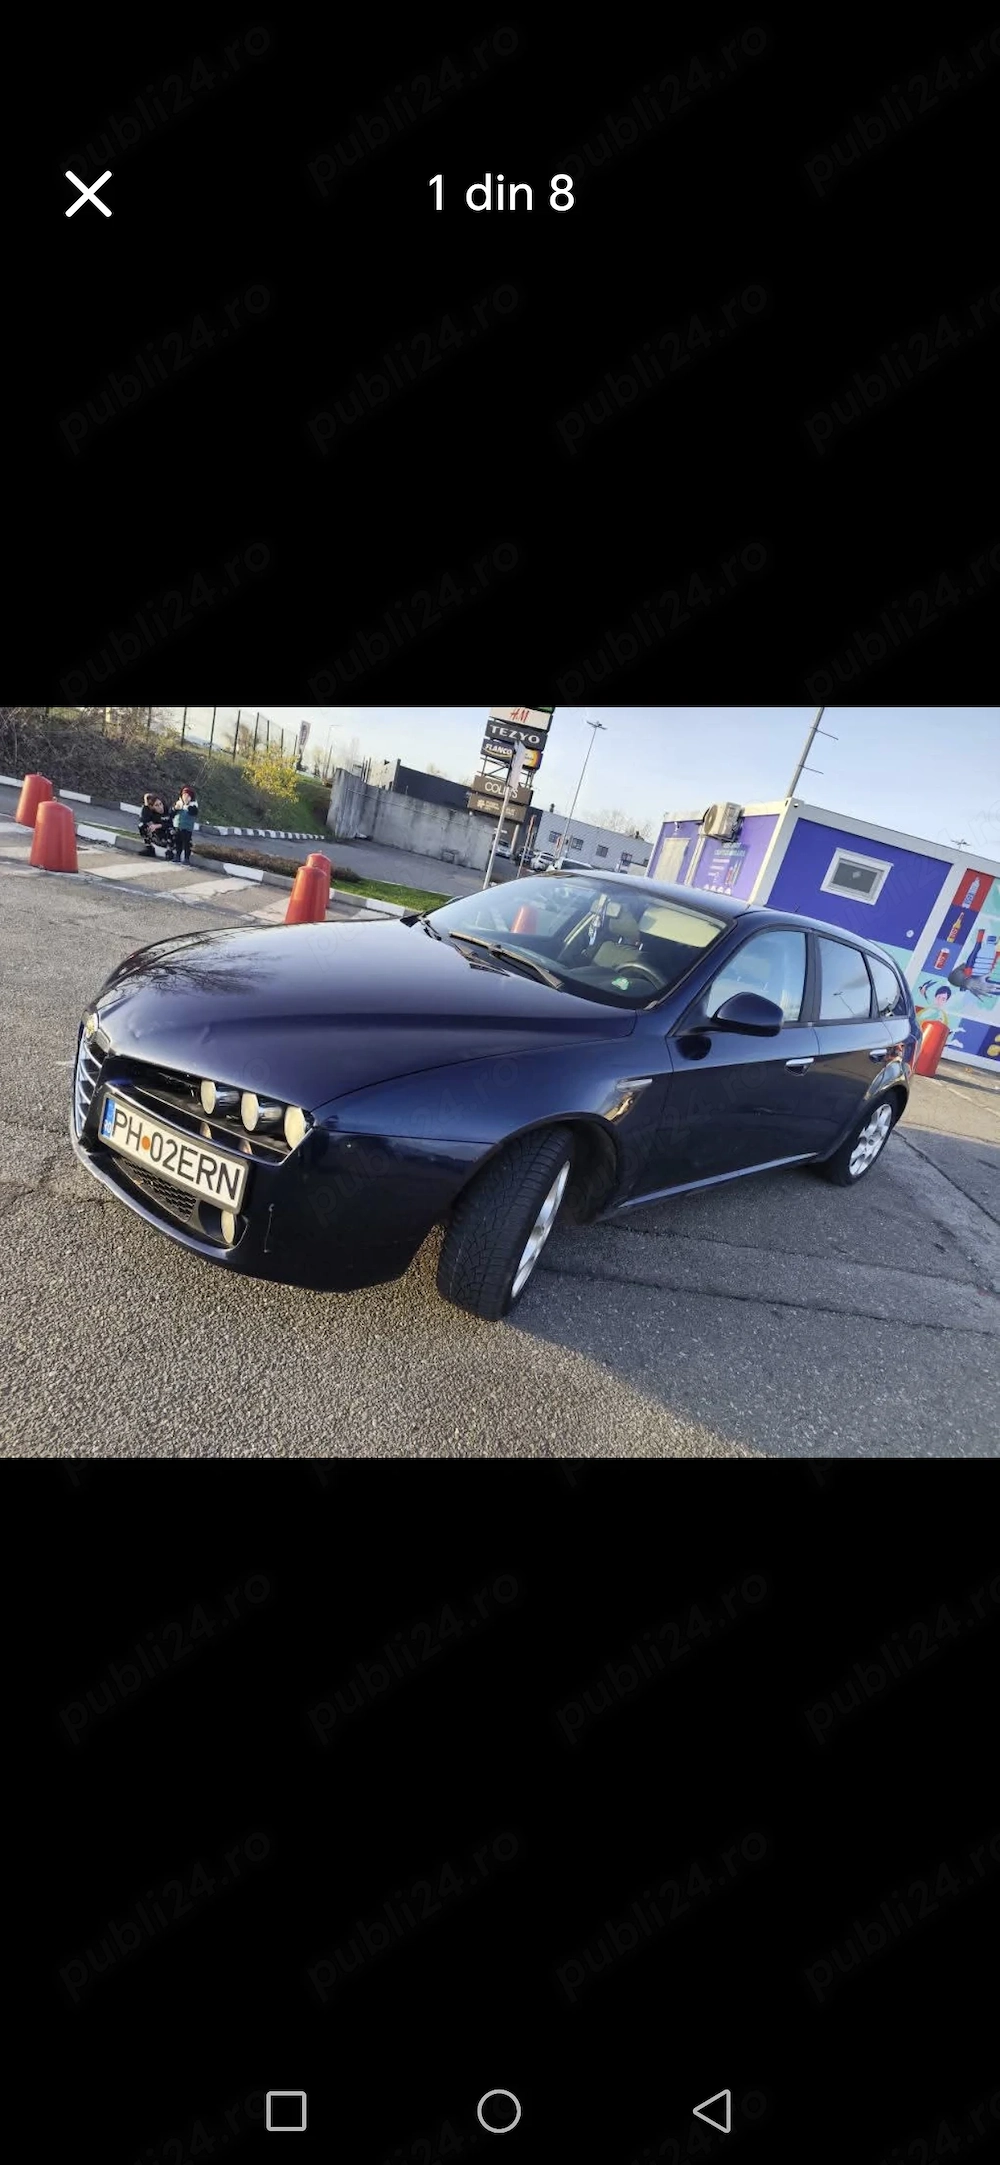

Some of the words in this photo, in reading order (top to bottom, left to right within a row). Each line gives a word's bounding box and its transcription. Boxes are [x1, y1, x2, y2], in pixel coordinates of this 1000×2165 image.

[490, 724, 540, 744] TEZYO
[485, 744, 513, 755] FLANCO
[485, 782, 518, 798] COLIS
